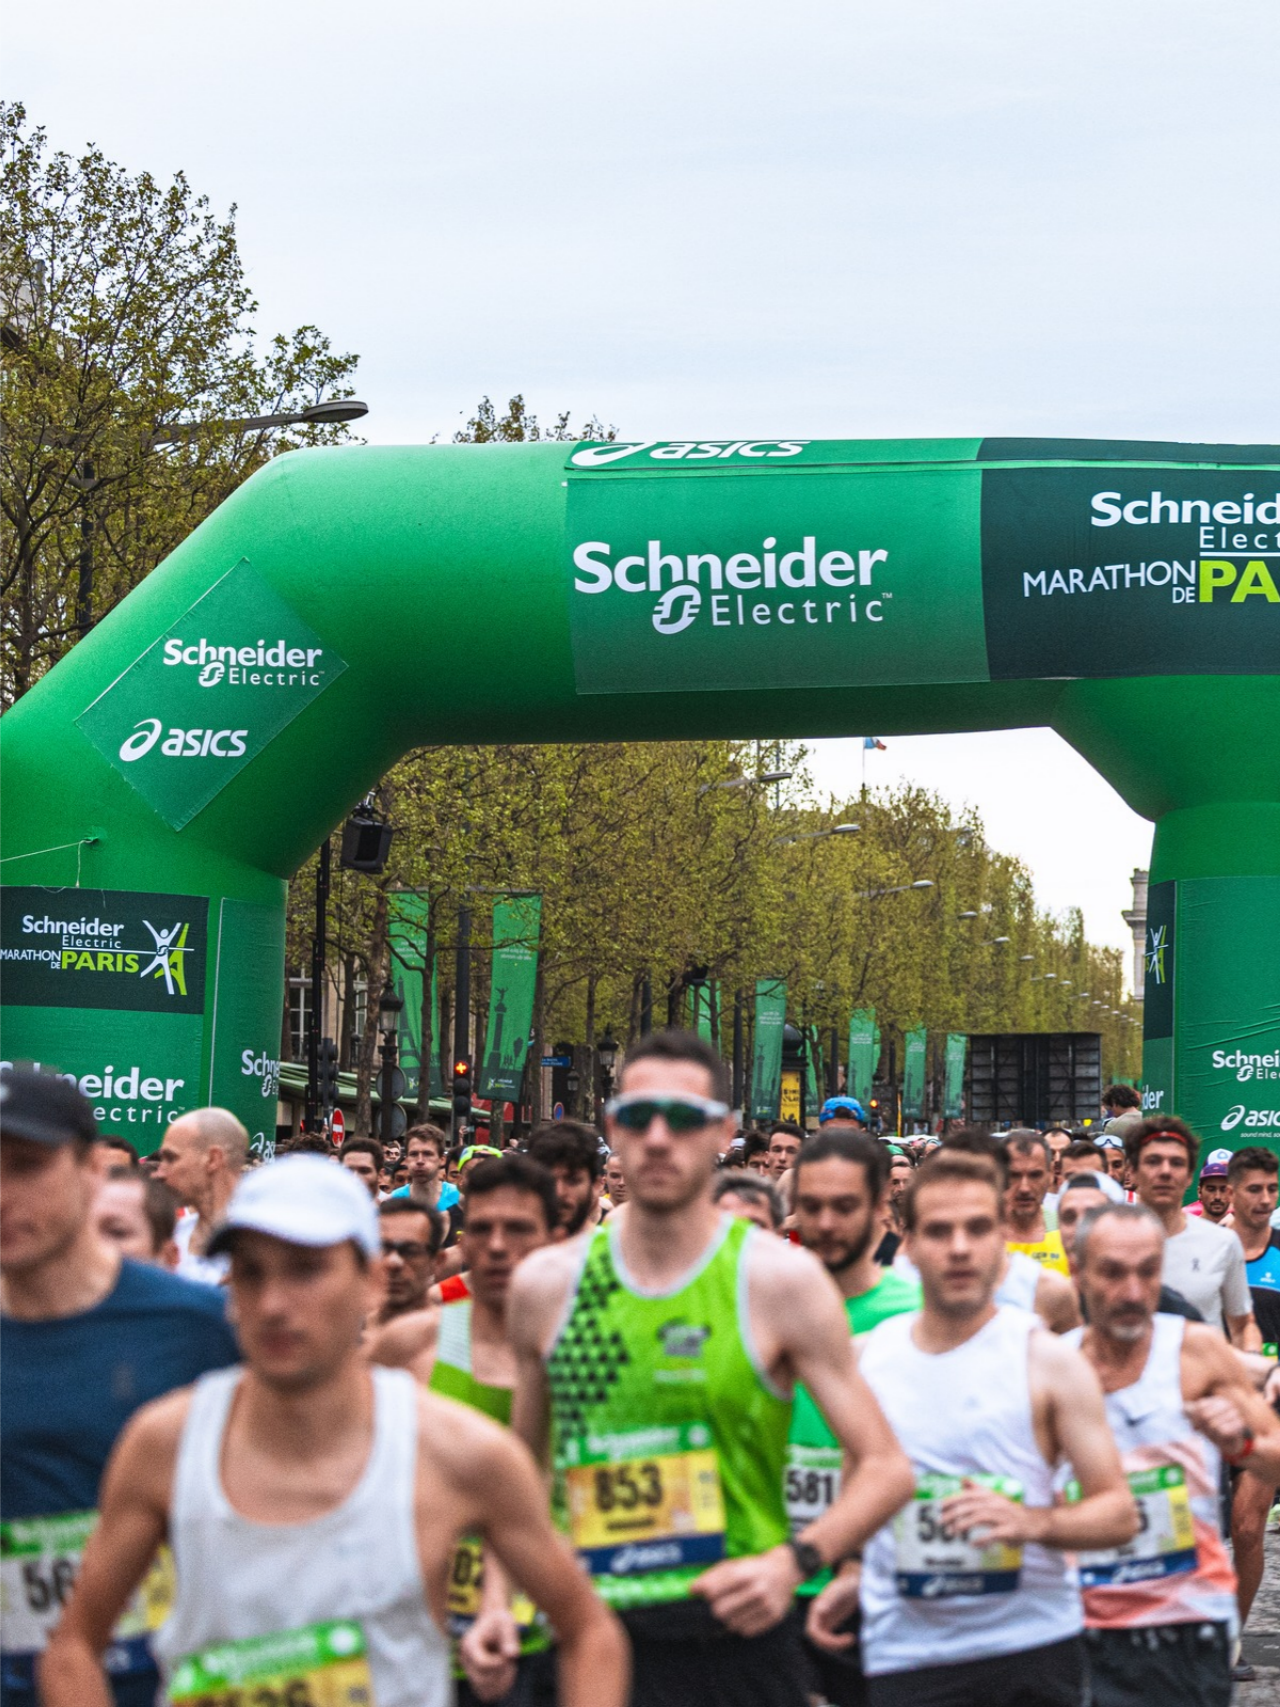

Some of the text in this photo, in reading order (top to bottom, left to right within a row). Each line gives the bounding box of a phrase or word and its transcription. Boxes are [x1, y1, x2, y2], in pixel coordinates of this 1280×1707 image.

[649, 440, 811, 460] asics
[572, 536, 889, 595] Schneider
[1022, 560, 1196, 598] MARATHON
[1172, 586, 1195, 604] DE
[711, 593, 884, 626] Electric
[162, 638, 323, 668] Schneider
[229, 666, 320, 686] Electric
[161, 728, 248, 757] asics
[22, 915, 124, 937] Schneider
[62, 934, 122, 949] Electric
[50, 961, 60, 969] DE
[61, 950, 140, 973] PARIS
[93, 1105, 179, 1124] ectric
[596, 1462, 662, 1513] 853
[787, 1469, 833, 1506] 581
